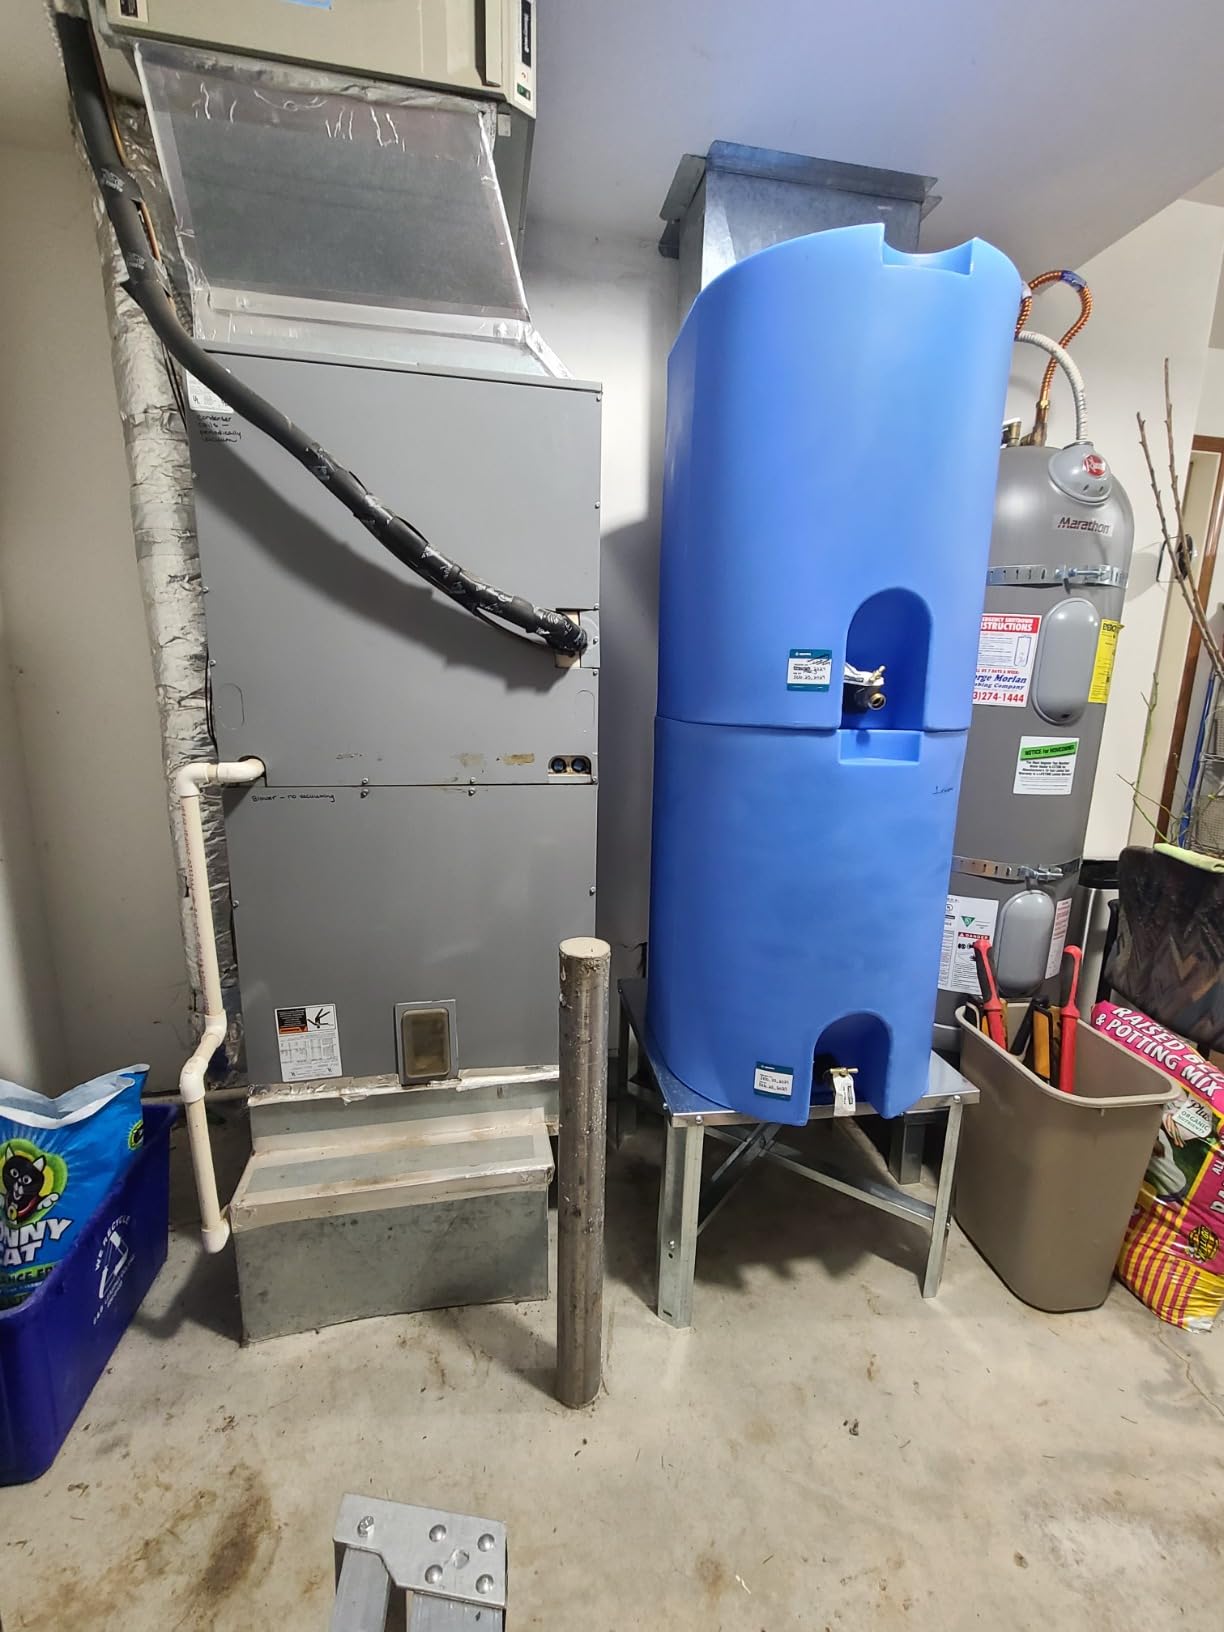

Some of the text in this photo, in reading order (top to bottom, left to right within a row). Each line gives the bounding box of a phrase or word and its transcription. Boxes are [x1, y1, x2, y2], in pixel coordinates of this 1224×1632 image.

[1057, 516, 1110, 534] Marathon
[981, 621, 1033, 632] STRUCTIONS
[973, 691, 1024, 703] 3)274-1444
[1112, 1007, 1185, 1051] RAISED
[1096, 1013, 1107, 1026] &
[1106, 1019, 1182, 1070] POTTING
[1181, 1065, 1223, 1097] MIX
[1181, 1110, 1209, 1131] ORGANIC
[1187, 1100, 1210, 1121] Plus
[0, 1218, 73, 1248] NNY
[102, 1215, 131, 1247] RECYCLE
[0, 1240, 42, 1266] AT
